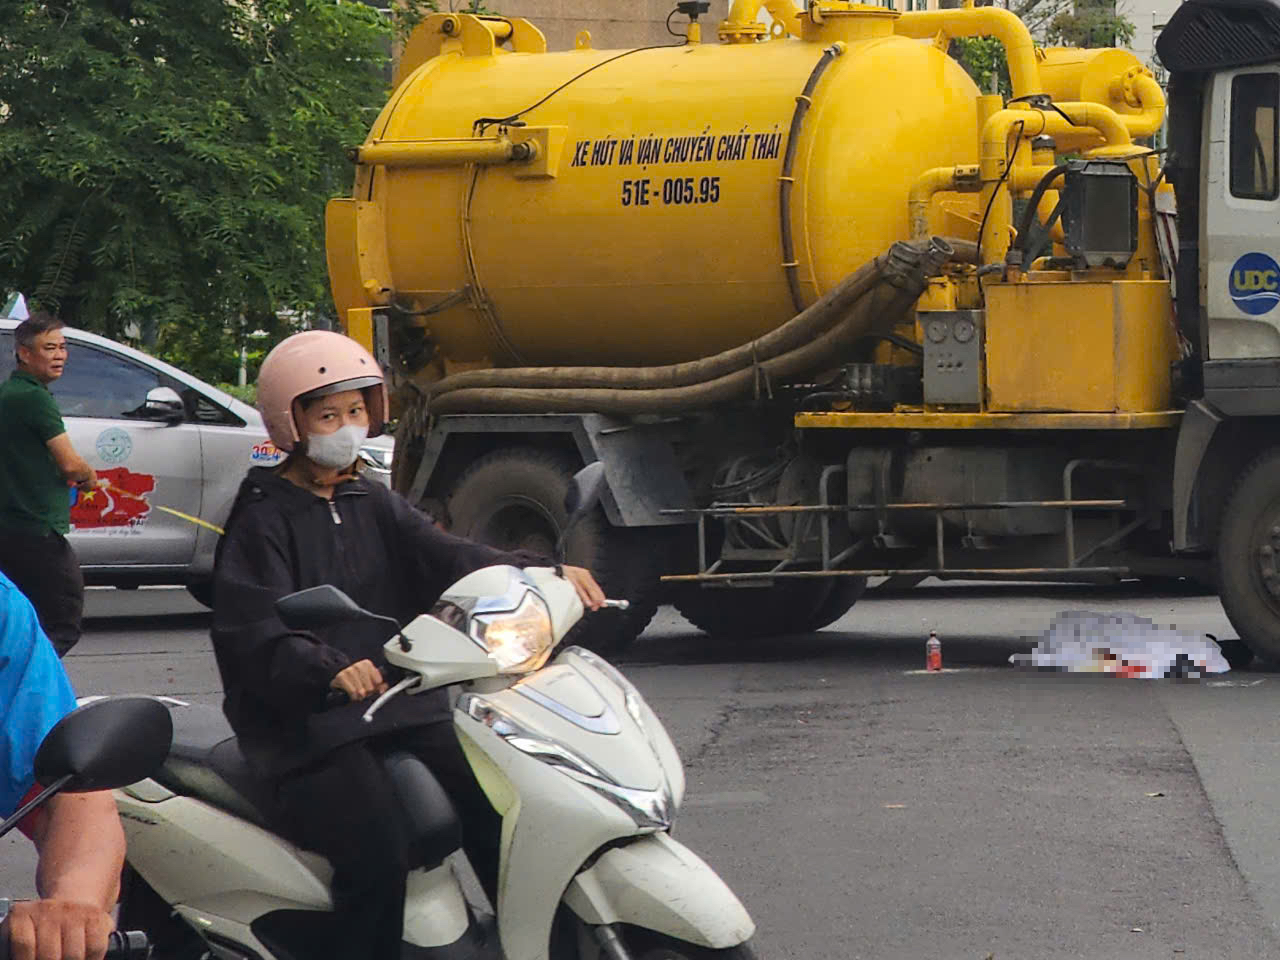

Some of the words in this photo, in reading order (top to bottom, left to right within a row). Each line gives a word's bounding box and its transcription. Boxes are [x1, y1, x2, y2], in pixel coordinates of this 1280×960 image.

[571, 141, 590, 166] XE
[591, 134, 617, 165] HÚT
[717, 124, 750, 161] CHẤT
[751, 123, 782, 160] THẢI
[622, 179, 650, 206] 51E
[663, 177, 720, 204] 005.95
[1234, 270, 1278, 290] UDC
